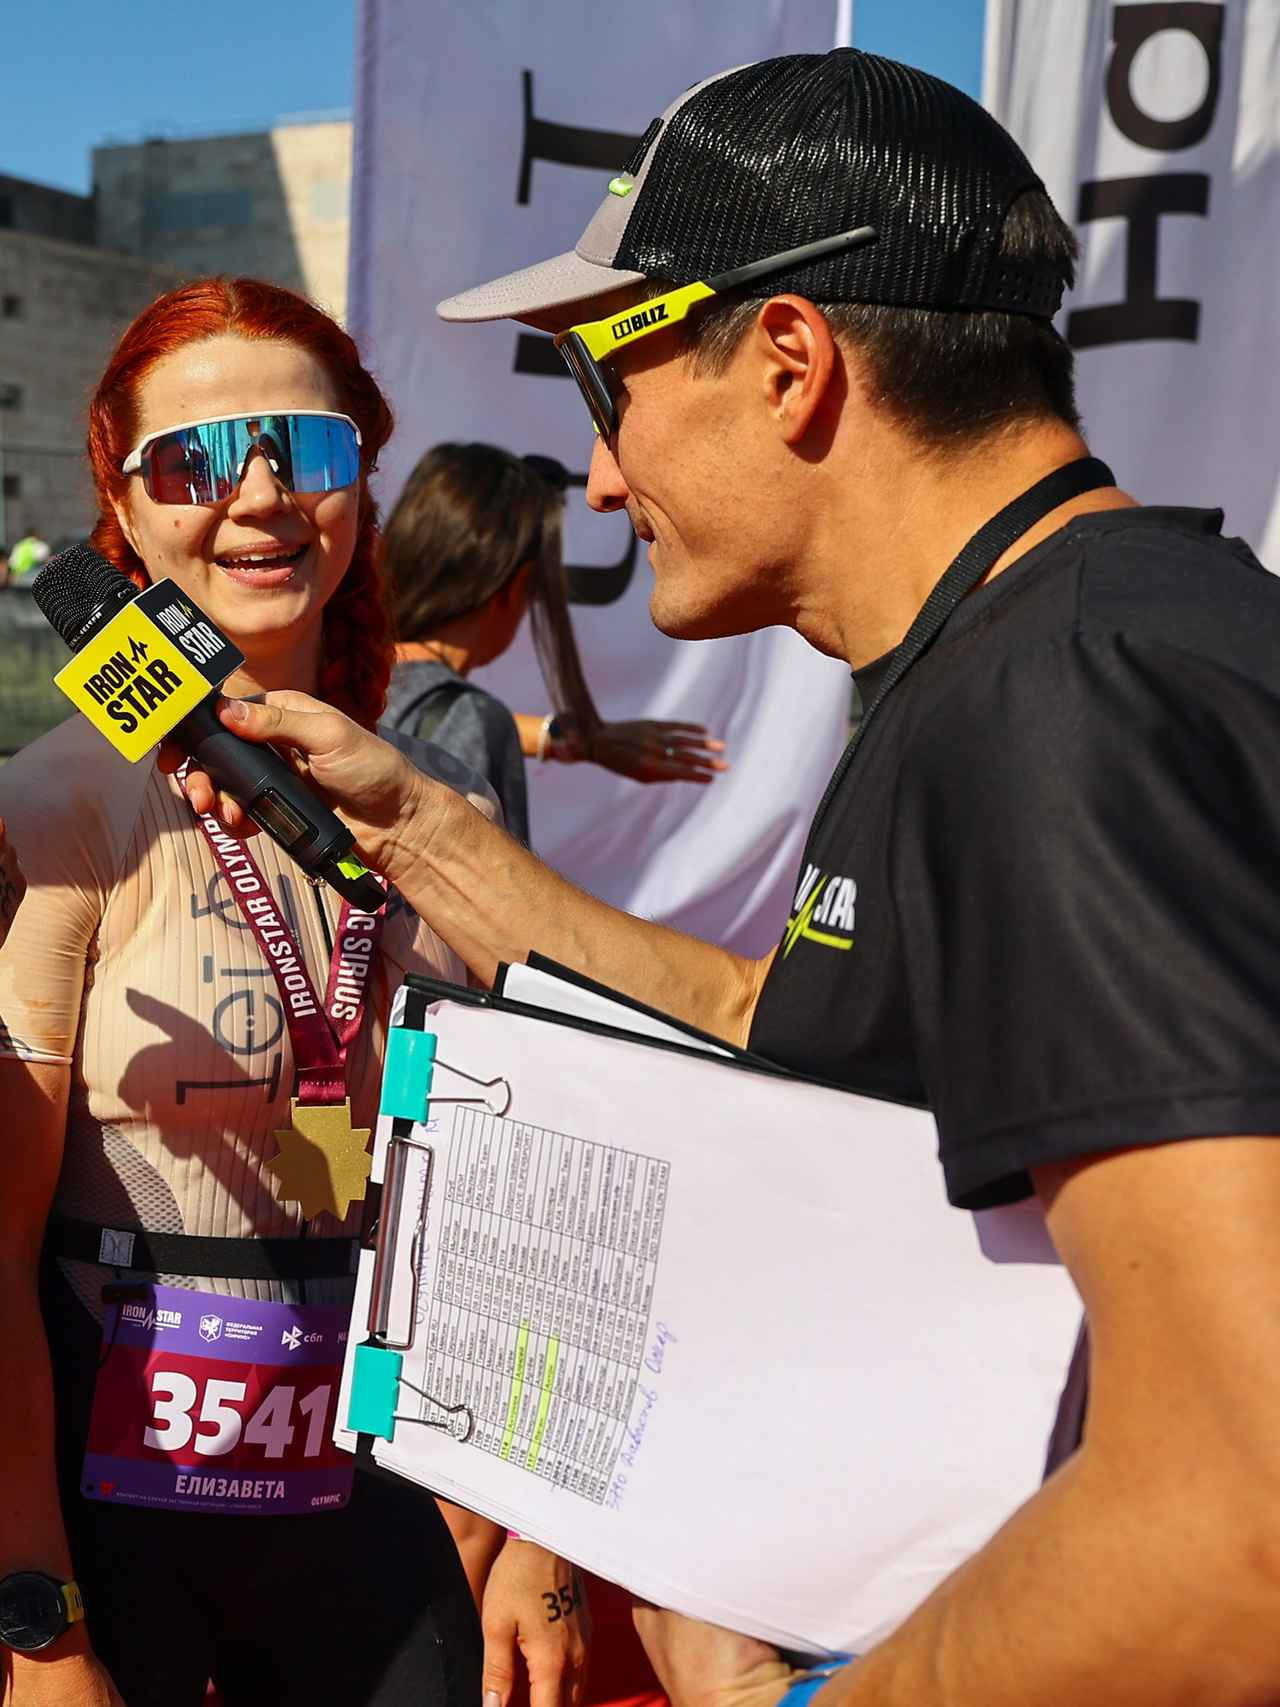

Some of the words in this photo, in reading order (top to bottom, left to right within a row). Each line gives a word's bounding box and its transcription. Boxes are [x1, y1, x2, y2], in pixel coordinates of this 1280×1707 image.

[630, 303, 669, 332] BLIZ
[156, 603, 192, 635] IRON
[179, 621, 226, 665] STAR
[82, 650, 137, 706] IRON
[106, 658, 184, 734] STAR
[201, 812, 261, 893] OLYMP
[245, 896, 318, 1018] IRONSTAR
[331, 936, 373, 1021] SIRIUS
[122, 1304, 147, 1320] IRON
[156, 1309, 183, 1325] STAR
[303, 1332, 323, 1343] сбп
[143, 1371, 332, 1458] 3541
[174, 1474, 286, 1499] ЕЛИЗАВЕТА
[310, 1493, 341, 1507] OLYMPIC
[541, 1579, 583, 1623] 354
